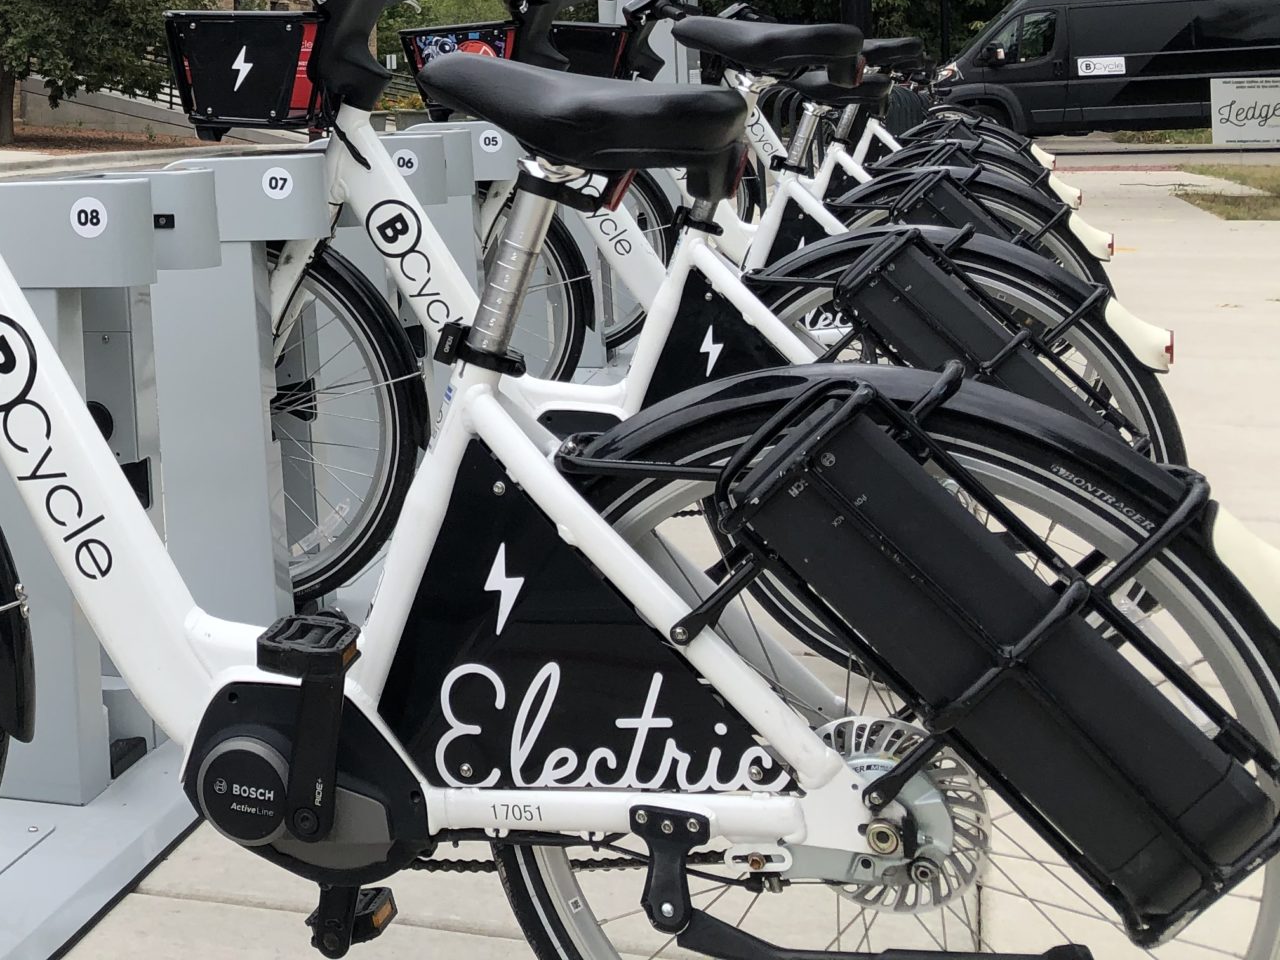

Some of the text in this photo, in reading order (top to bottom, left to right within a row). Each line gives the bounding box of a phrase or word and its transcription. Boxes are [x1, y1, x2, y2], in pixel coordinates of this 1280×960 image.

[483, 136, 499, 147] 05
[397, 156, 414, 169] 06
[269, 176, 288, 191] 07
[77, 209, 101, 227] 08
[1062, 468, 1156, 530] BONTRAGER
[434, 661, 792, 793] Electric
[232, 783, 275, 801] BOSCH
[490, 803, 544, 823] 17051
